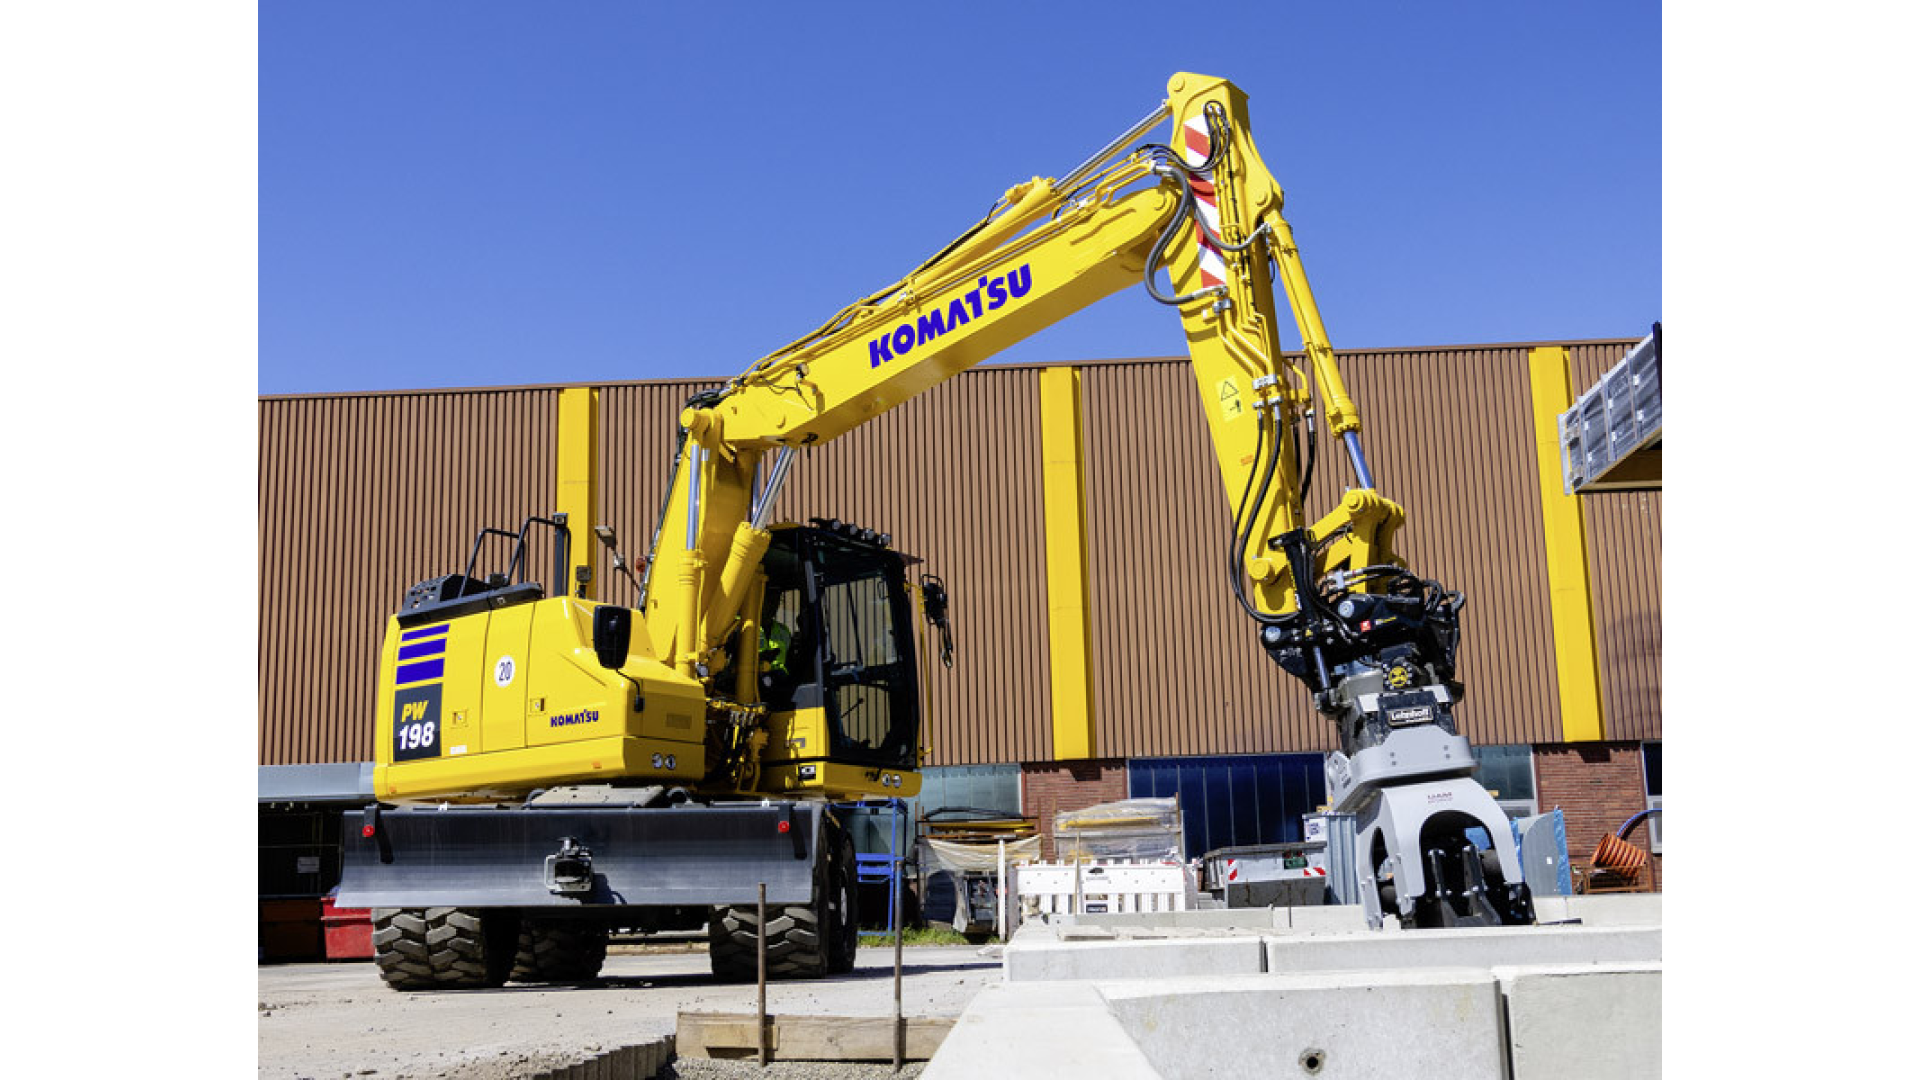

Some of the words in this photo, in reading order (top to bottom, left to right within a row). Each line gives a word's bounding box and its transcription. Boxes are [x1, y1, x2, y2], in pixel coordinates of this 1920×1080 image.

[868, 263, 1033, 369] KOMATSU
[498, 661, 513, 681] 20
[401, 700, 430, 722] PW
[549, 709, 600, 728] KOMATSU
[398, 721, 435, 749] 198
